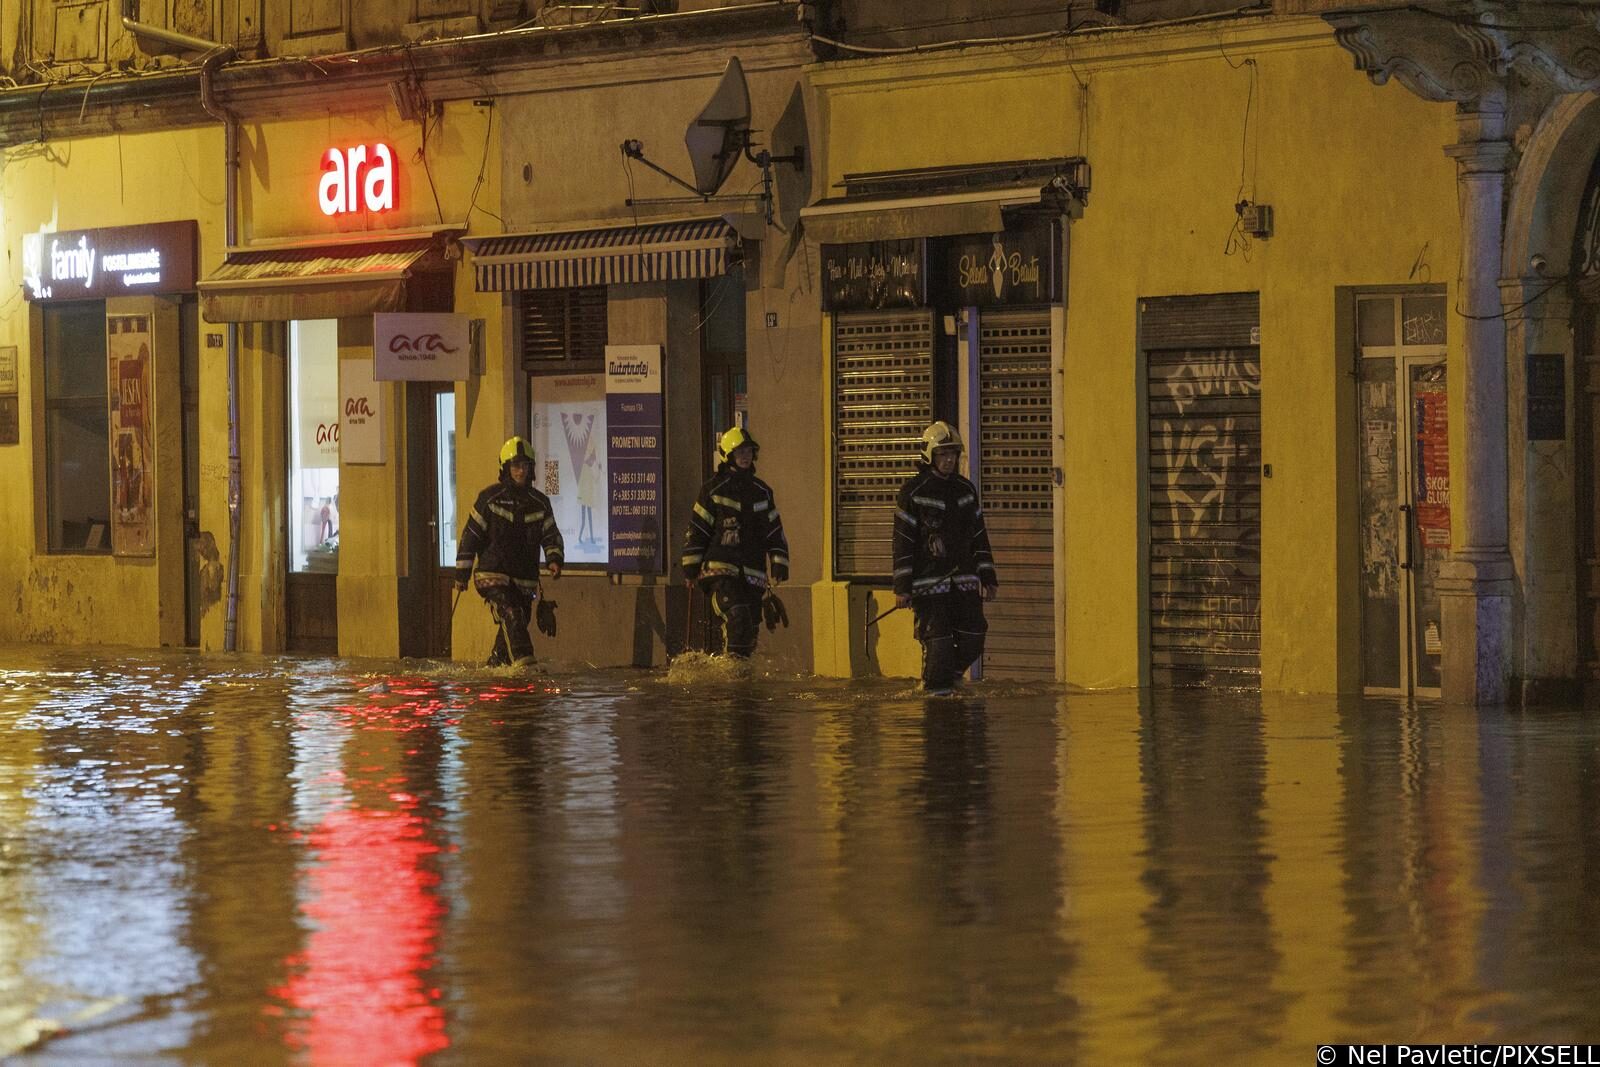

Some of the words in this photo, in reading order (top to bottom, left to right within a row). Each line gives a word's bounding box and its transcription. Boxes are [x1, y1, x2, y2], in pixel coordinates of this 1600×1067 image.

[318, 143, 396, 216] ara
[51, 235, 95, 288] family
[1008, 252, 1039, 298] Beauty
[389, 334, 460, 354] ara
[345, 397, 376, 417] ara
[611, 436, 641, 449] PROMETNI
[641, 436, 657, 449] URED
